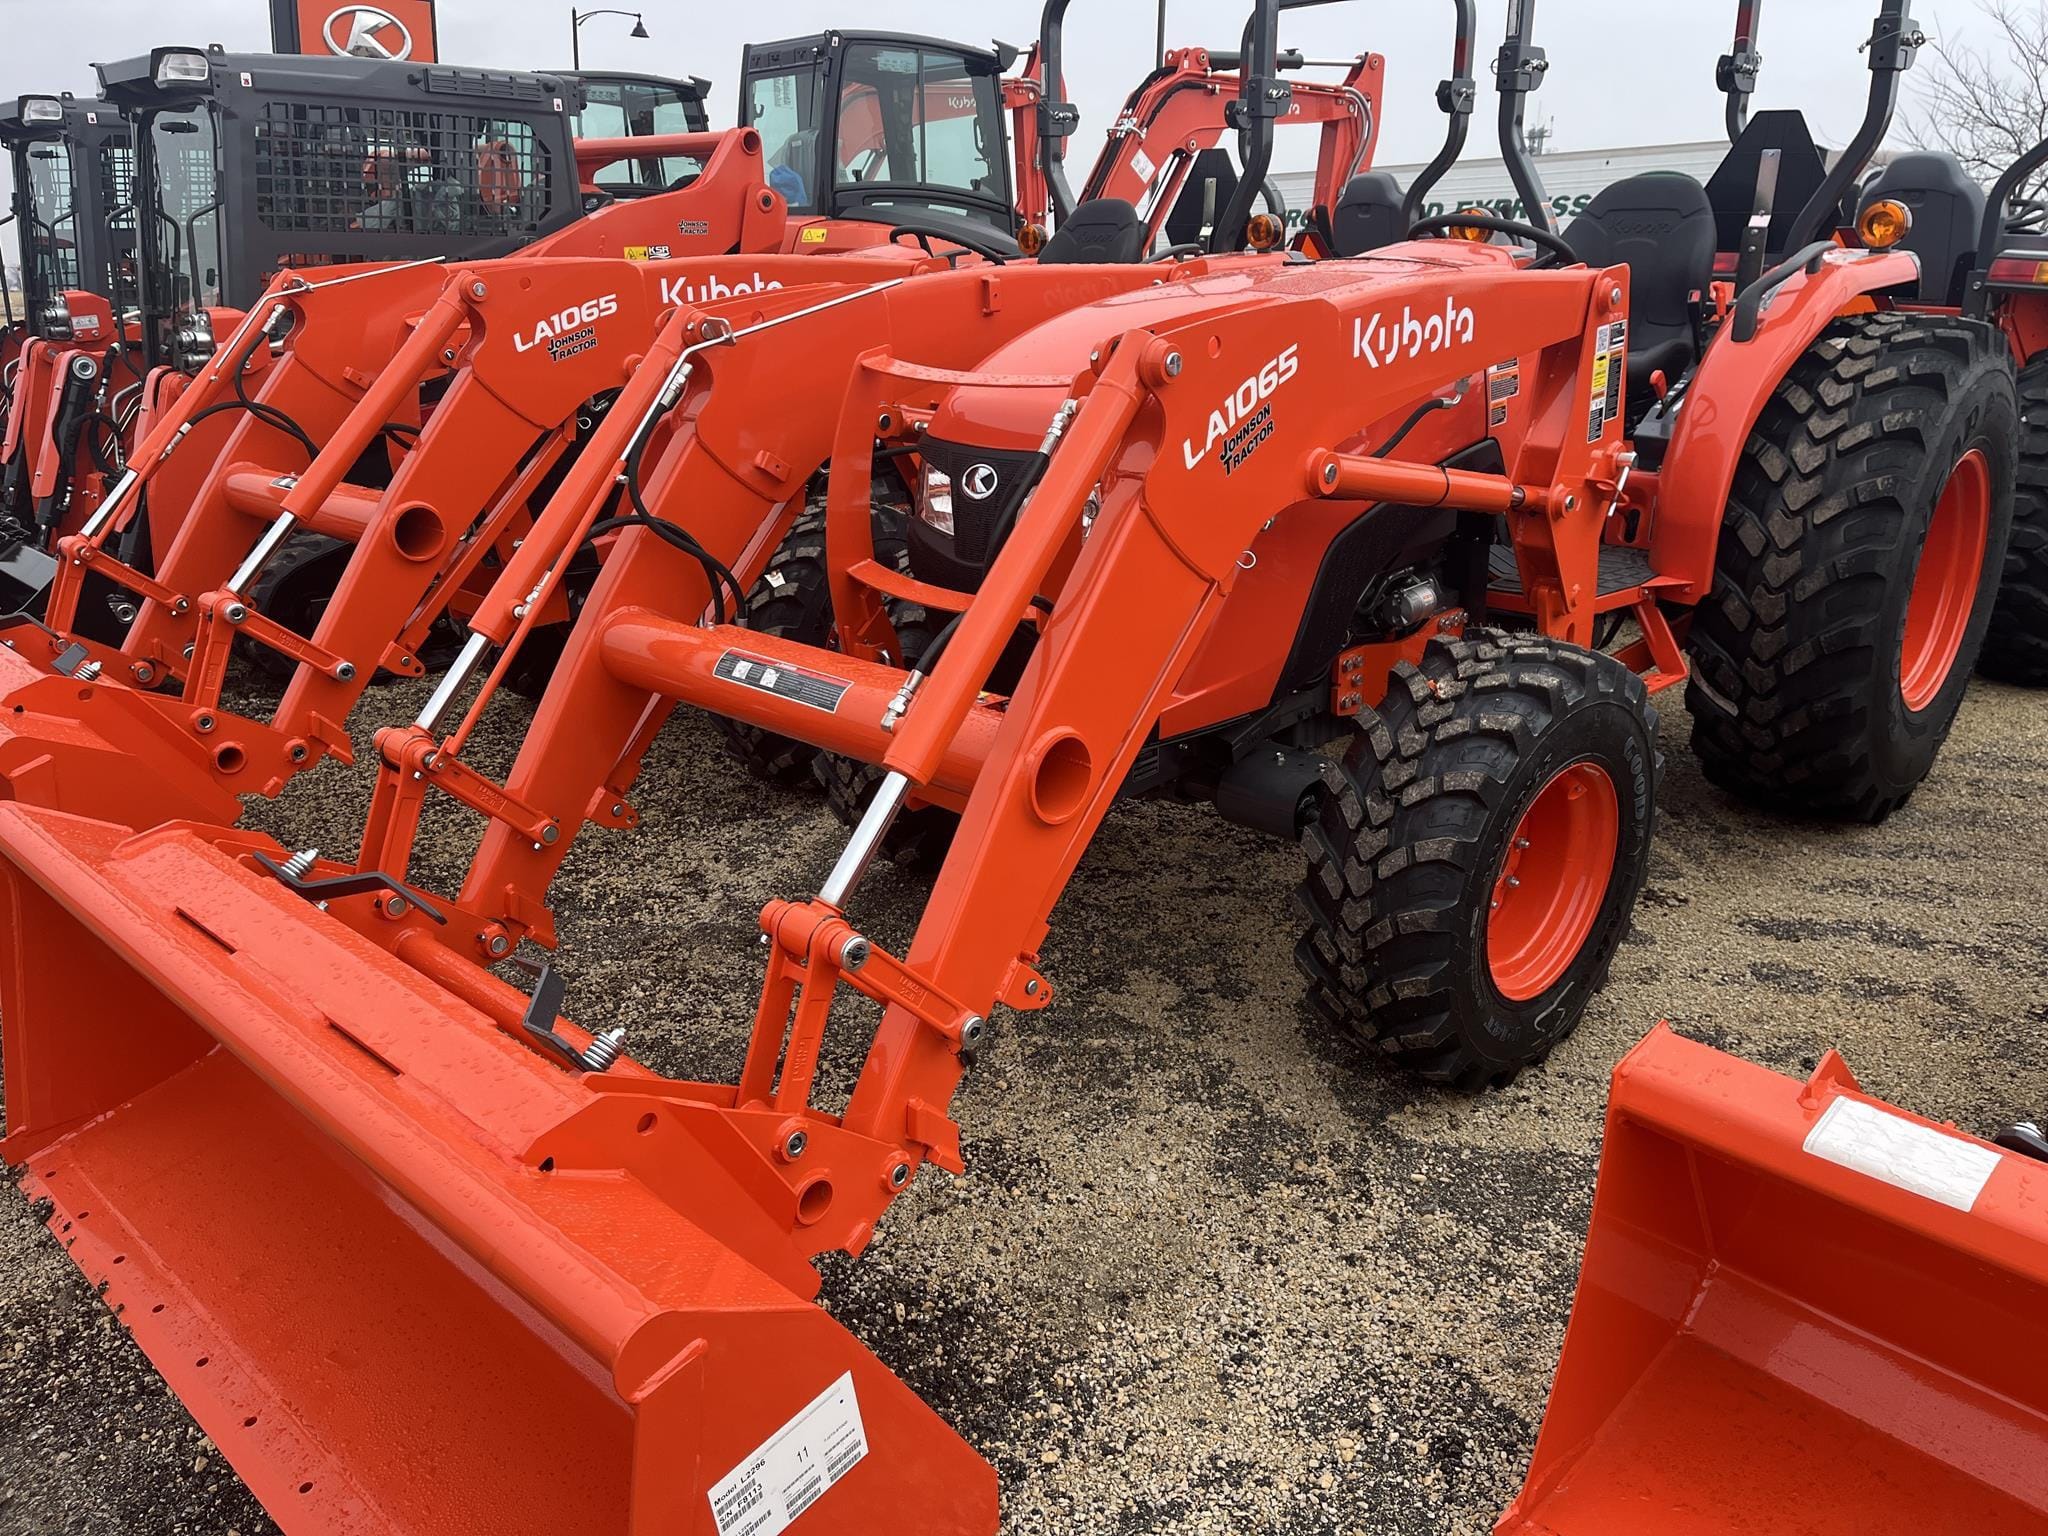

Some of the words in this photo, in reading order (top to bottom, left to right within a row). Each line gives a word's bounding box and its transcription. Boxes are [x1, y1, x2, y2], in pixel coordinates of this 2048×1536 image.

[948, 95, 977, 109] Kubo
[649, 245, 670, 256] KSR
[513, 293, 618, 353] LA1065
[547, 326, 594, 352] JOHNSON
[1353, 295, 1475, 369] Kubota
[550, 337, 597, 362] TRACTOR
[1183, 342, 1299, 470] LA1065
[1220, 402, 1271, 462] JOHNSON
[1223, 421, 1274, 476] TRACTOR
[714, 1483, 737, 1507] Model
[740, 1458, 766, 1484] L2296
[720, 1509, 733, 1525] S/N
